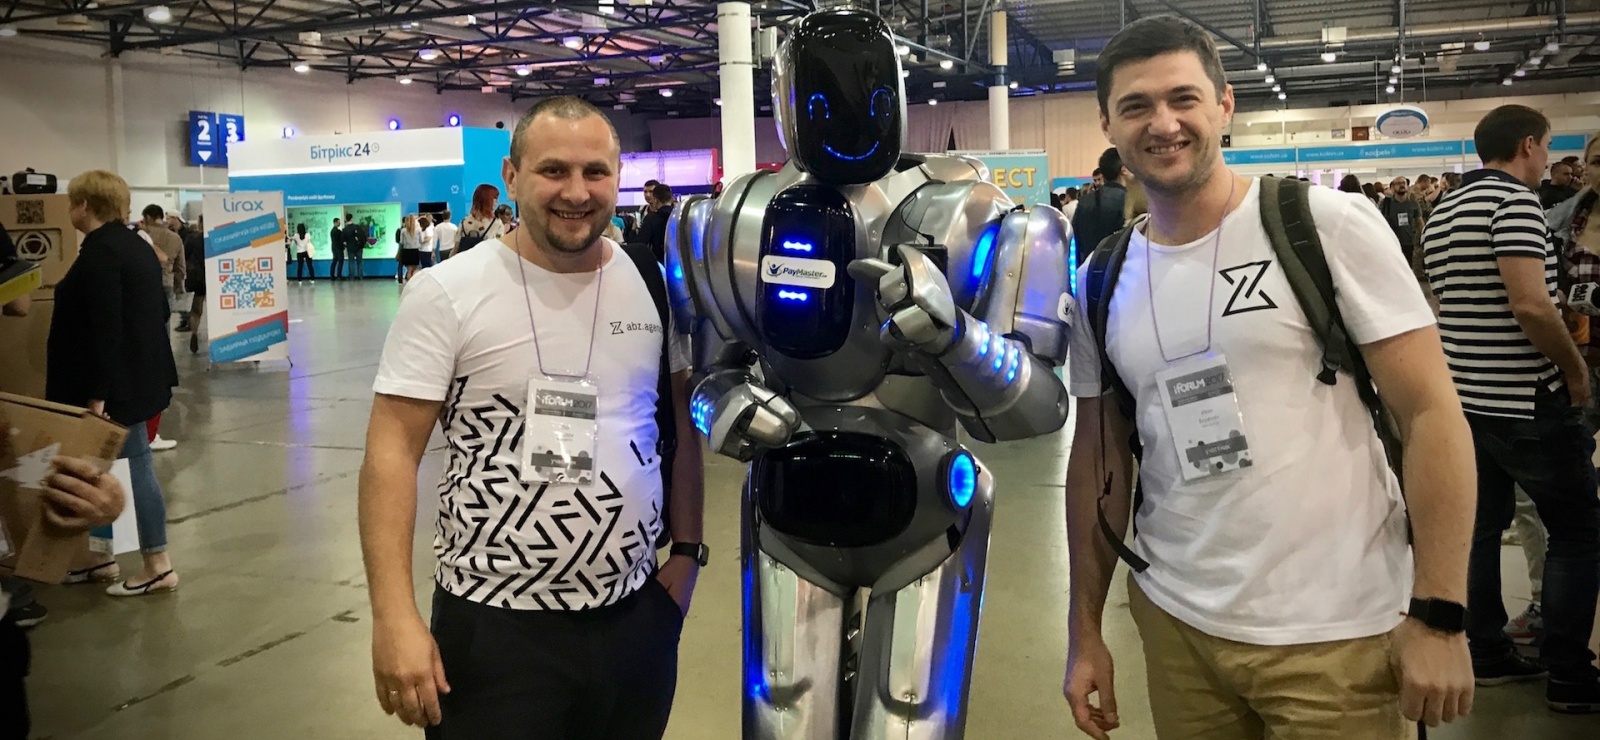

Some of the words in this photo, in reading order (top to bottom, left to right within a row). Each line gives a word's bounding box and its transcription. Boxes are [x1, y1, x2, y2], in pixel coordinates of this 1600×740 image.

[197, 119, 211, 141] 2
[225, 122, 238, 142] 3
[223, 197, 264, 213] Lirax
